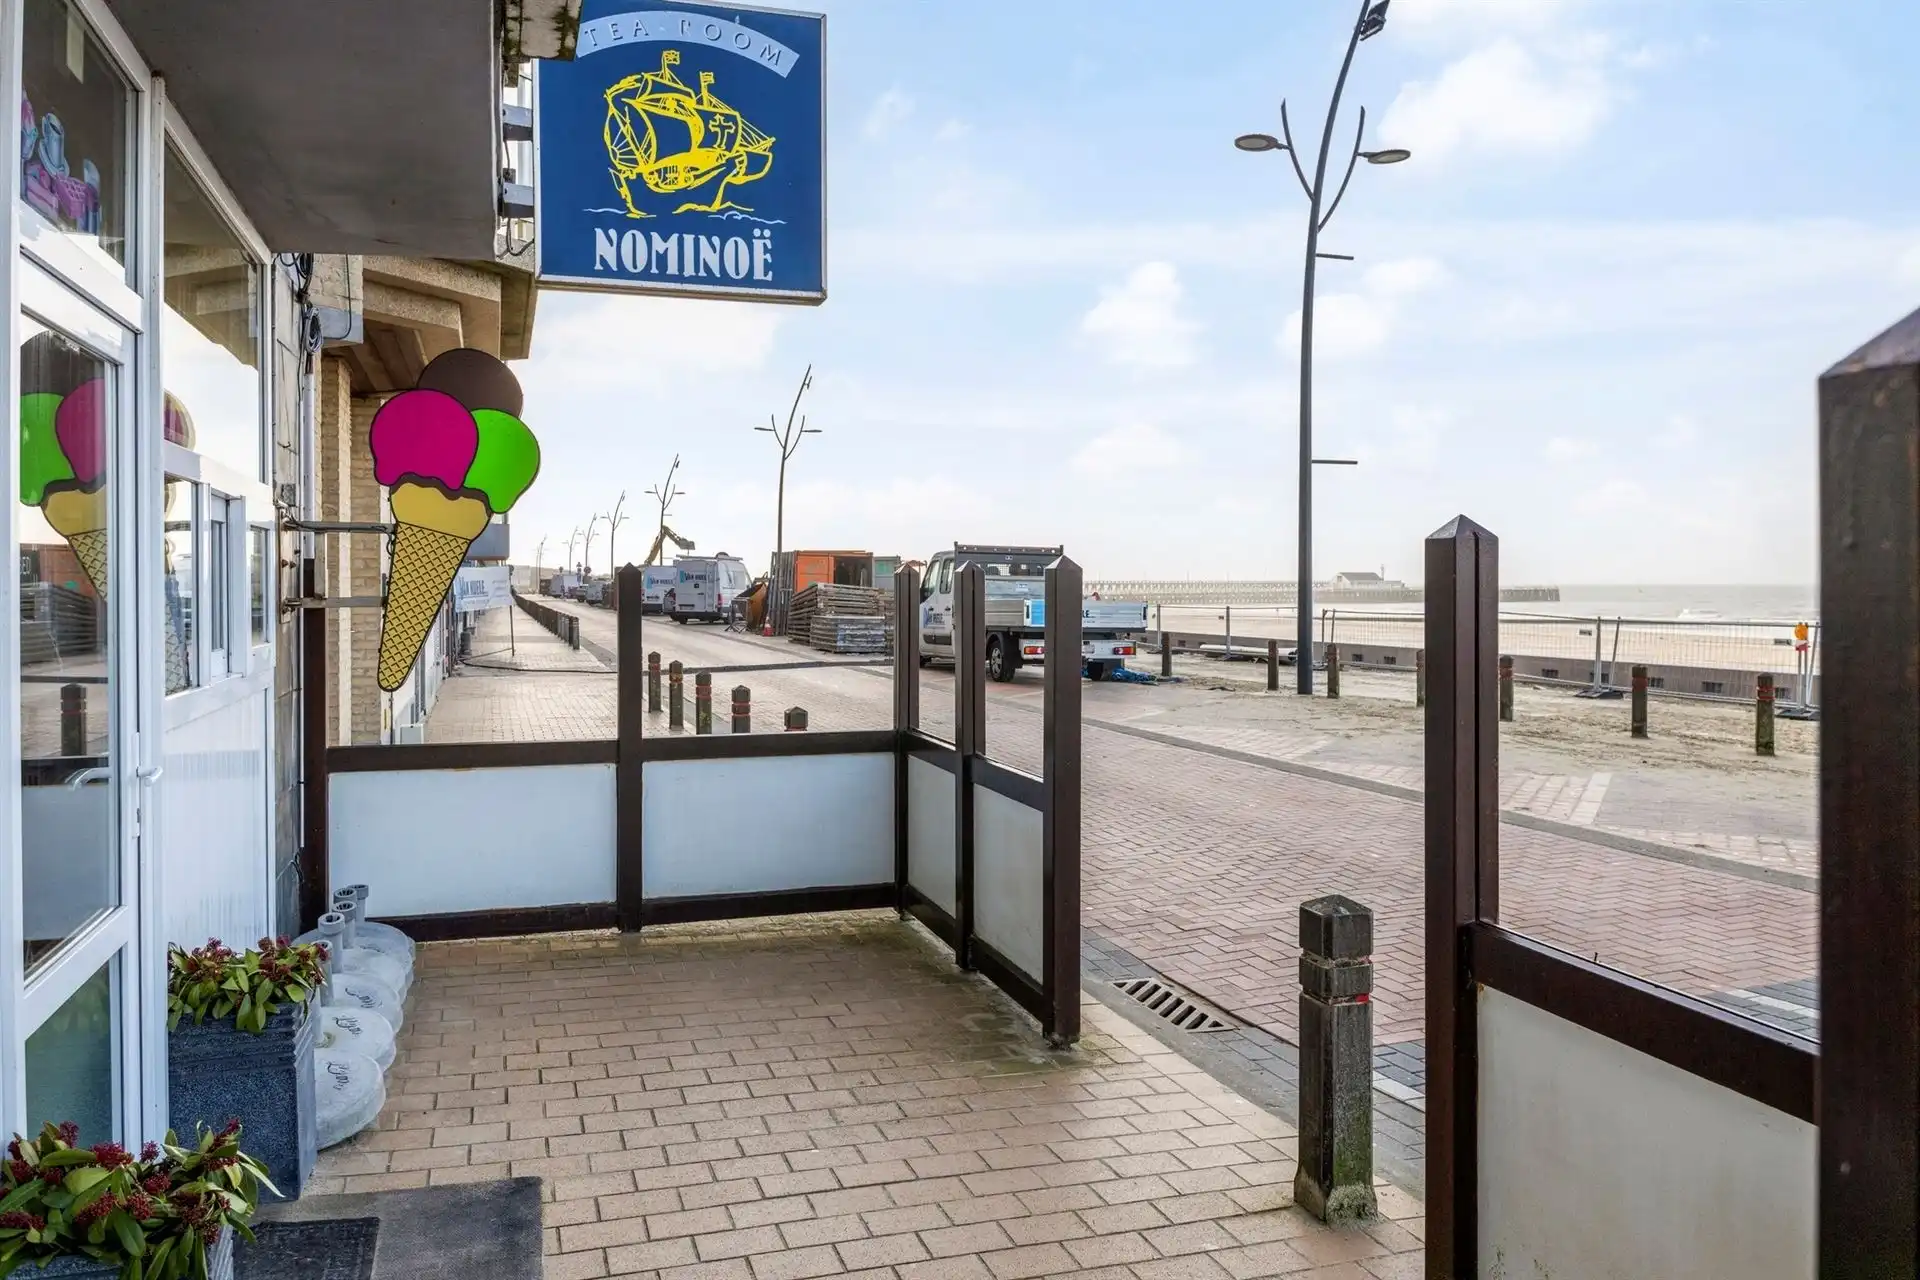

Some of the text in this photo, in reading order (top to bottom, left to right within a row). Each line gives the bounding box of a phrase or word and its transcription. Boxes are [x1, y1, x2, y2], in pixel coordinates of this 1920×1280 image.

[584, 18, 782, 67] TEA ROOM
[593, 227, 773, 282] NOMINOË
